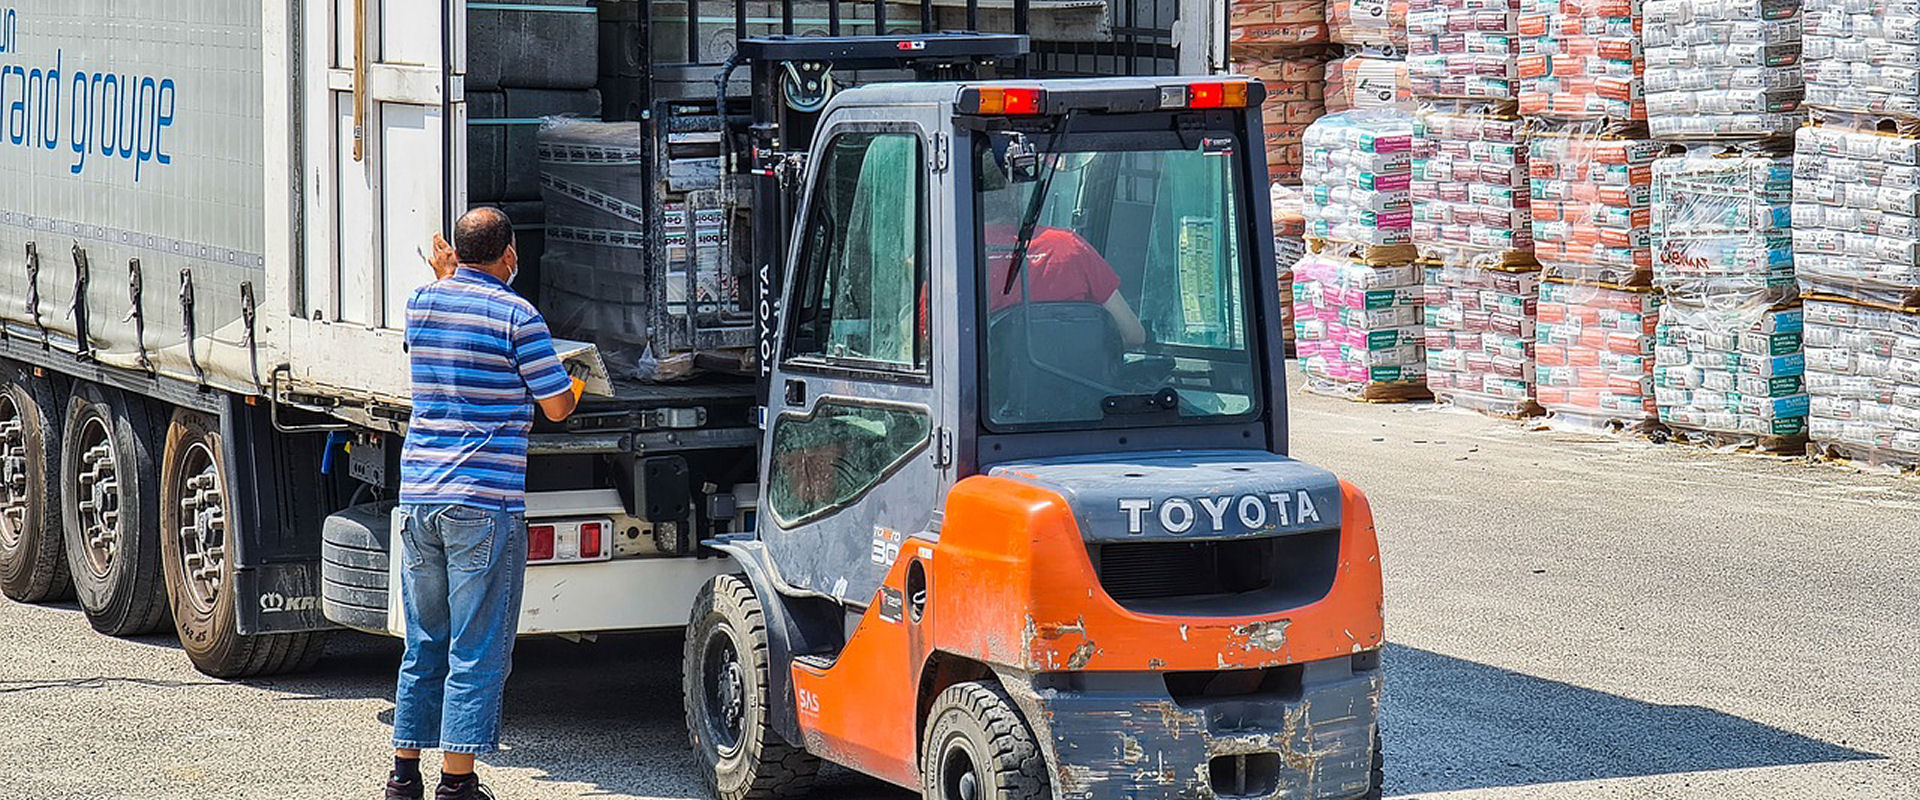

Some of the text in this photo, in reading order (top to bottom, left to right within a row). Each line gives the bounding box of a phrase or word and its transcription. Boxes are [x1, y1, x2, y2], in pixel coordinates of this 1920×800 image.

[0, 48, 175, 182] rand groupe
[759, 264, 772, 378] TOYOTA
[1119, 489, 1320, 534] TOYOTA
[871, 538, 898, 566] 30
[799, 689, 820, 712] SAS
